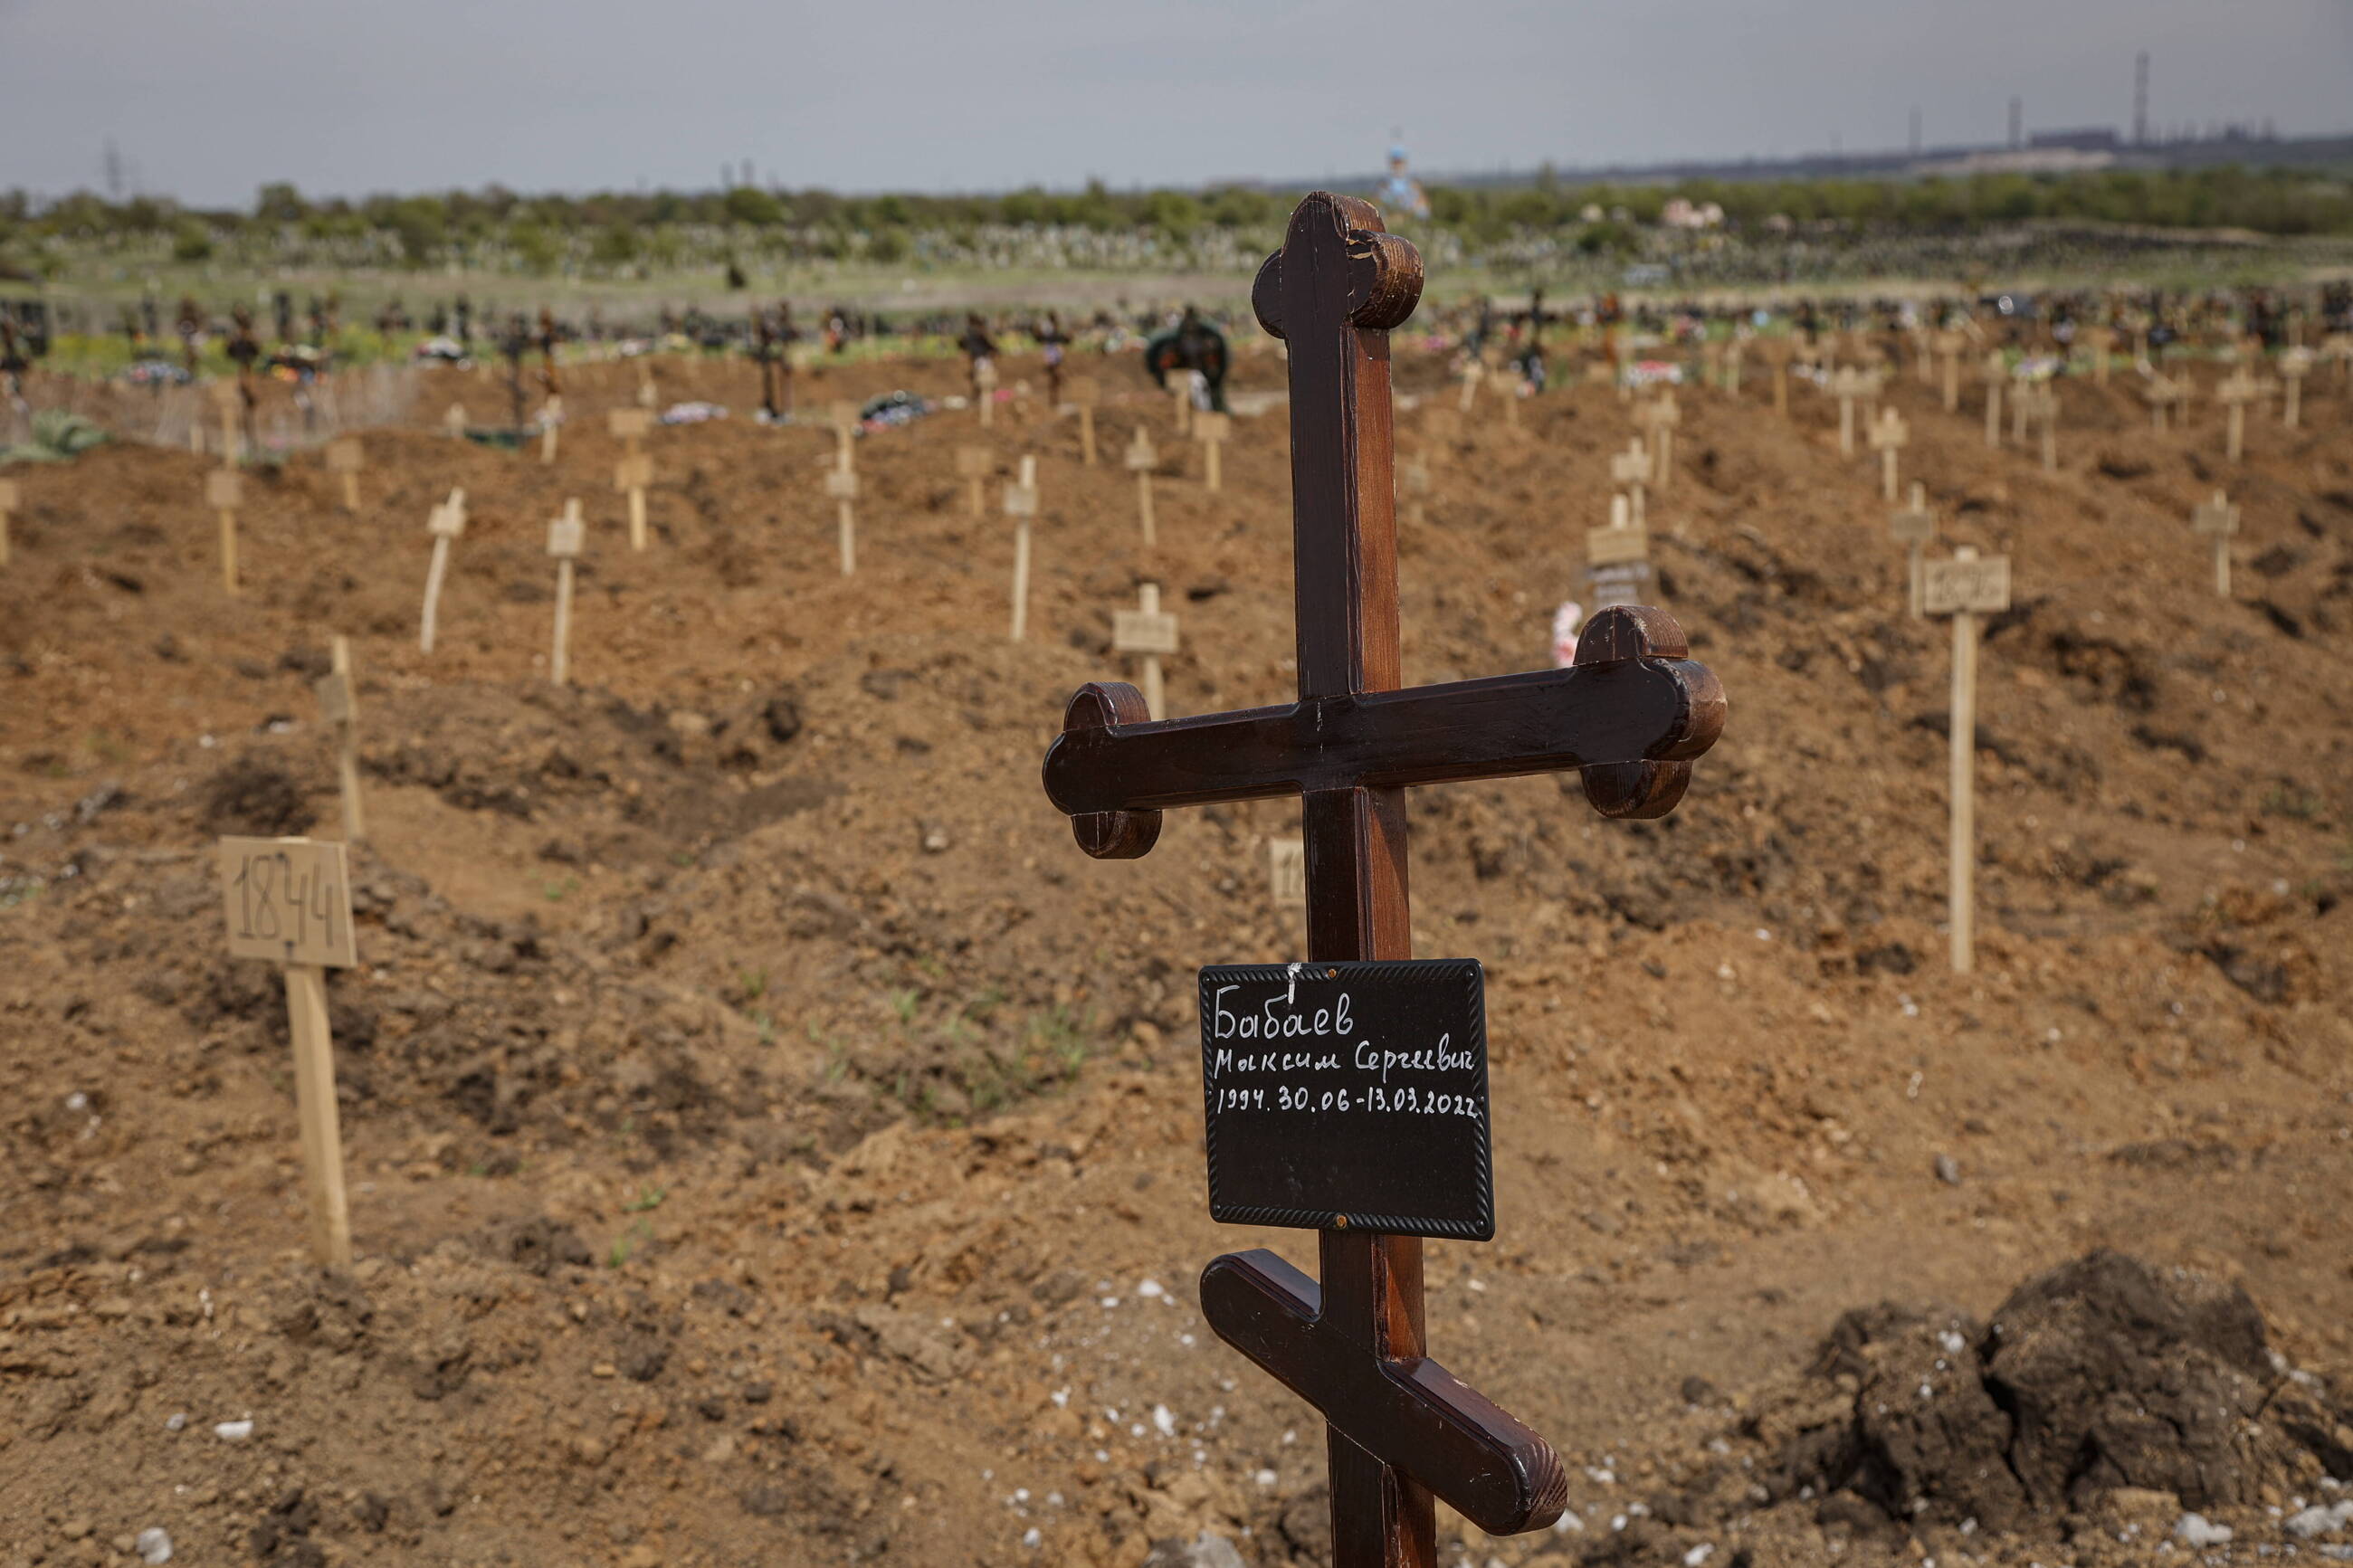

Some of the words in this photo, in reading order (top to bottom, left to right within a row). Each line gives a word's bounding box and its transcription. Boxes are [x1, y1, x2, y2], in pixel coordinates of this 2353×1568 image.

[233, 854, 334, 948] 1844
[1215, 984, 1354, 1040] Бабаев
[1214, 1048, 1341, 1079] Максим
